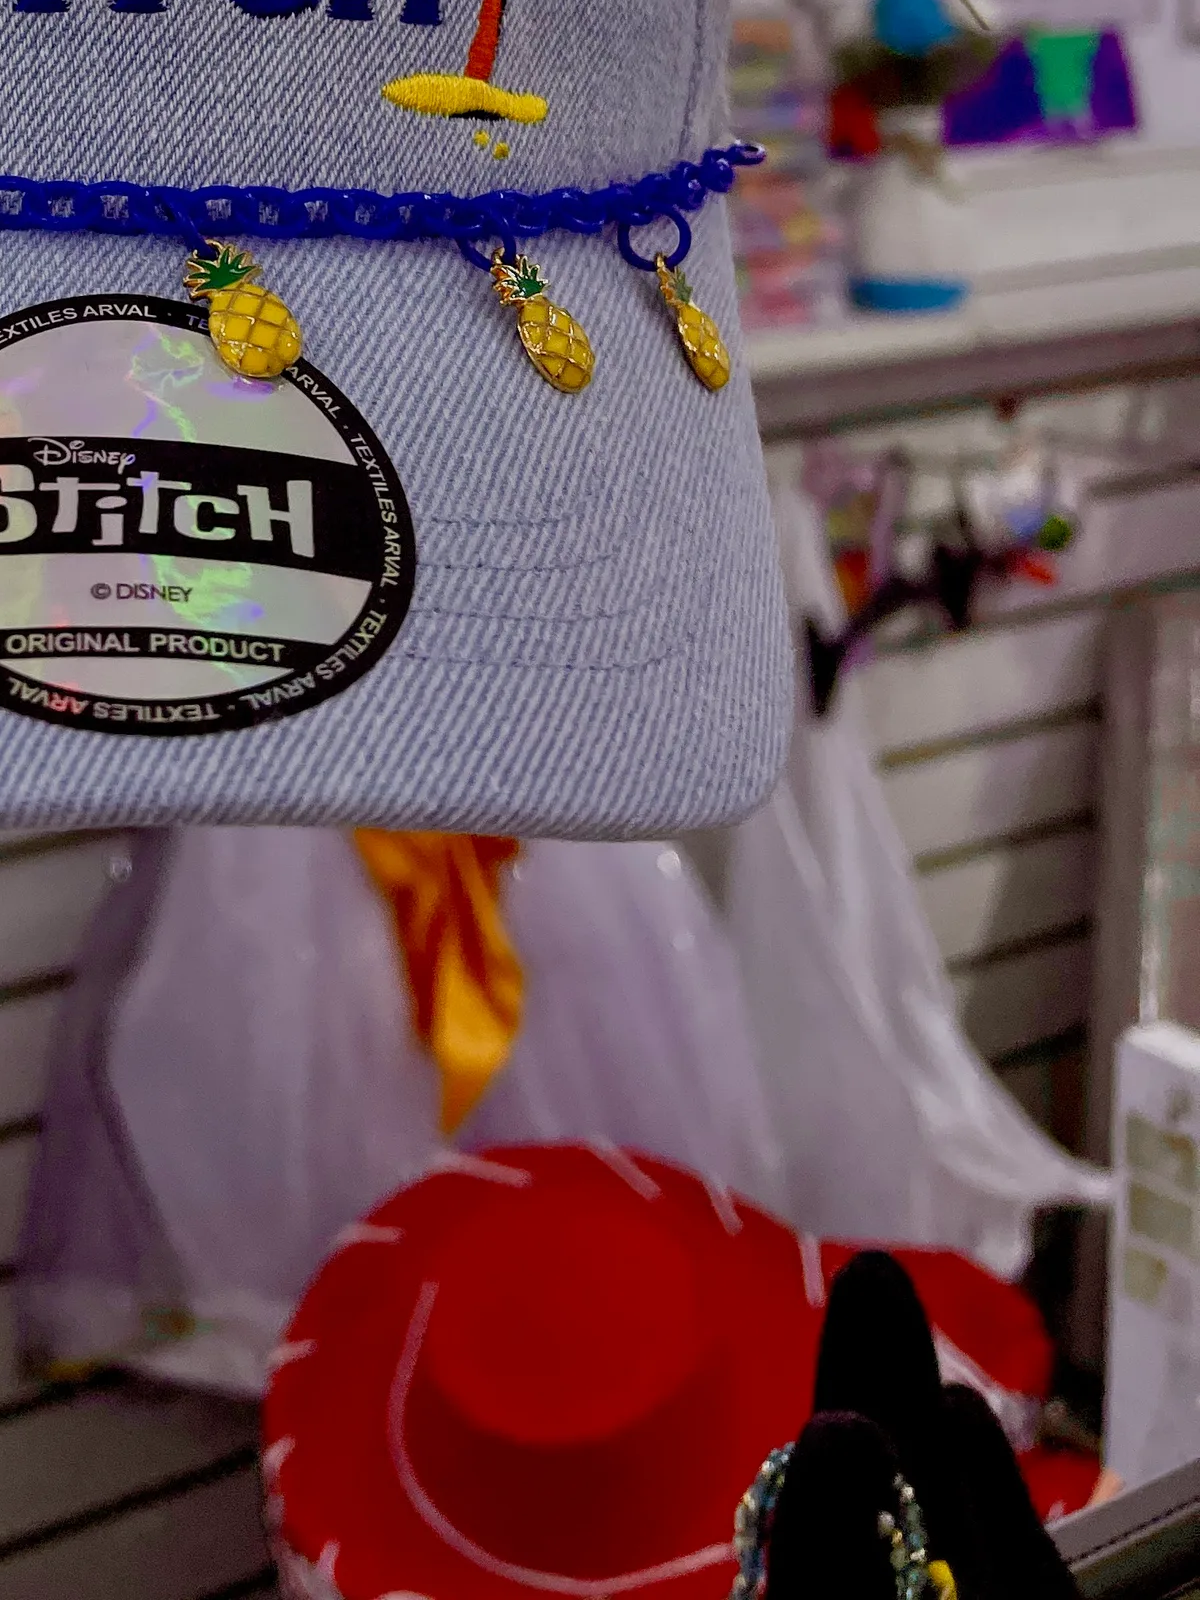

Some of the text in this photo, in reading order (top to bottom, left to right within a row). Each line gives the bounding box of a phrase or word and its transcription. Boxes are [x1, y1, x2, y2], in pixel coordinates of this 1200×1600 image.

[82, 303, 158, 319] ARVAL
[285, 365, 340, 420] ARVAL
[350, 432, 401, 589] TEXTILES ARVAL
[116, 583, 193, 603] DISNEY
[5, 632, 286, 662] ORIGINAL PRODUCT
[239, 608, 388, 711] TEXTILES ARVAL
[7, 676, 222, 724] TEXTILES ARVAL
